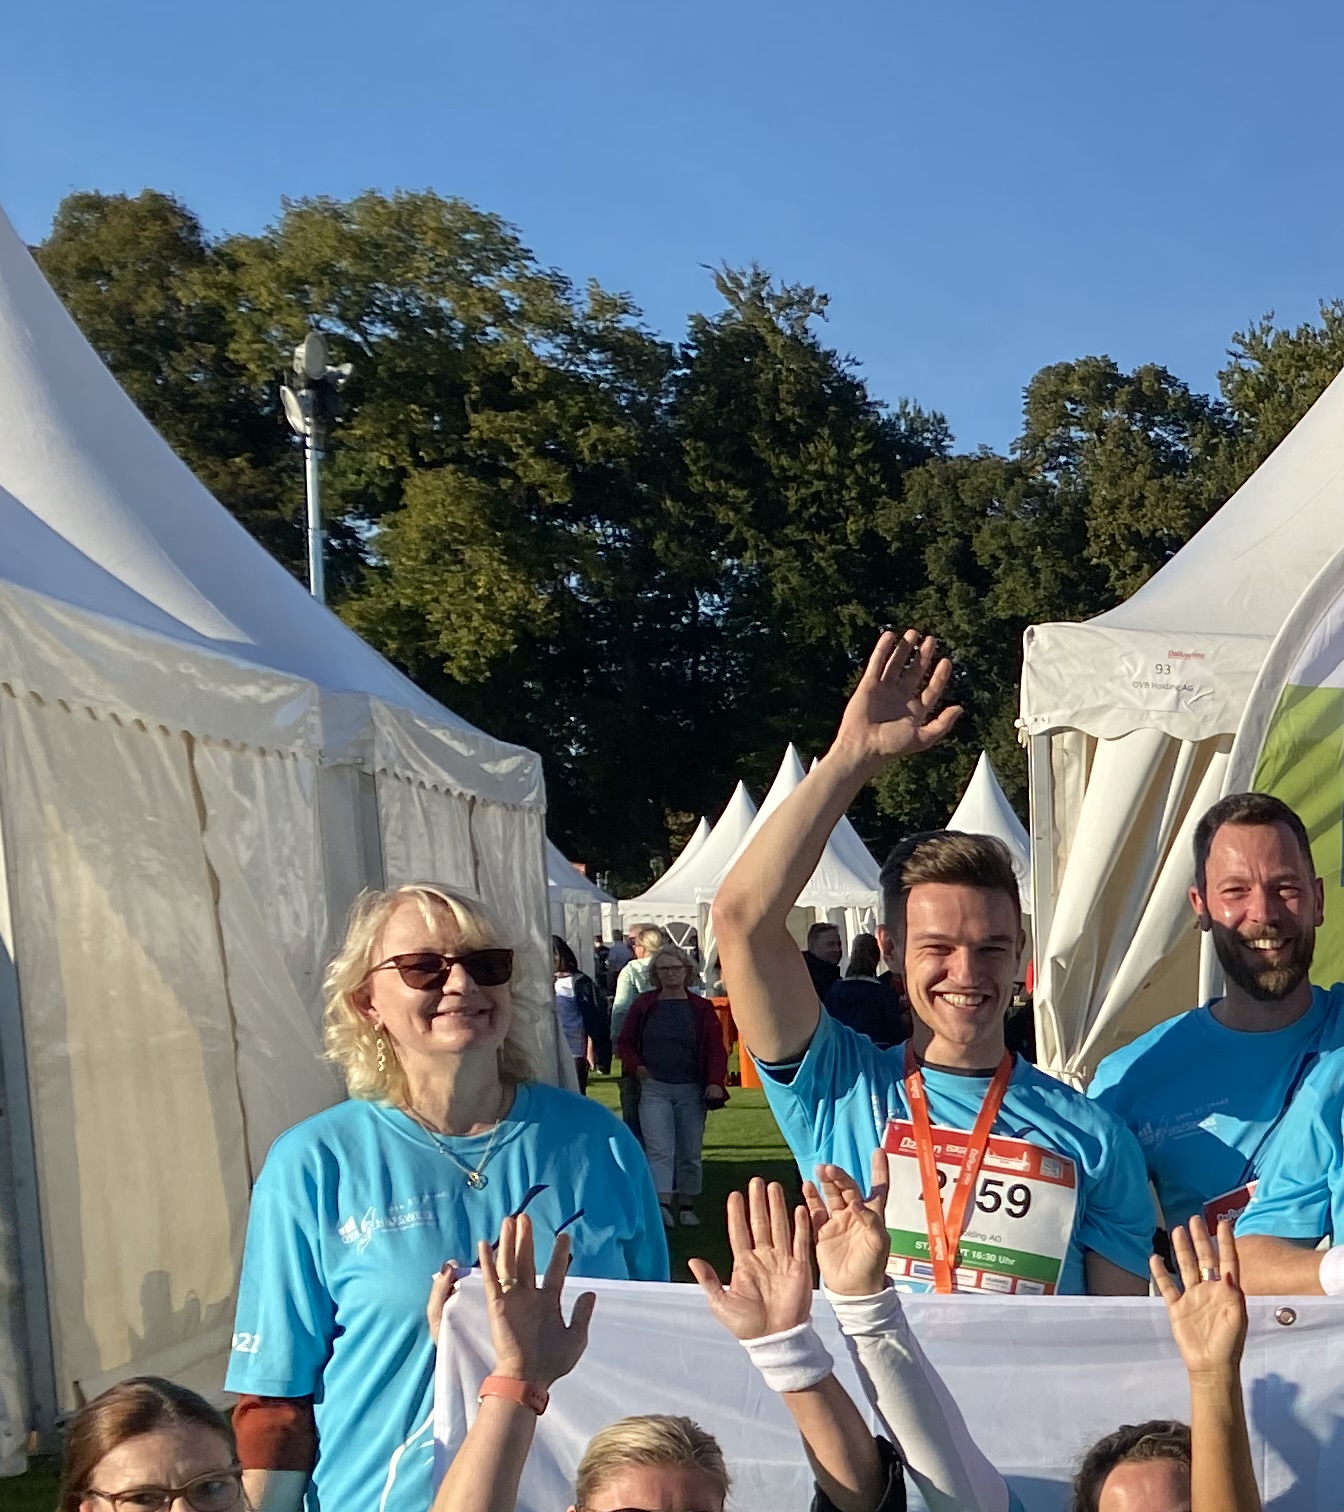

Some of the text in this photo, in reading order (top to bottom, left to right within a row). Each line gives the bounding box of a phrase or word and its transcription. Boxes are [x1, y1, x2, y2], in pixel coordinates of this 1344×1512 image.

[1155, 663, 1171, 675] 93
[1132, 681, 1150, 689] OVB
[919, 1168, 1032, 1219] 59
[963, 1230, 987, 1241] olding
[998, 1254, 1016, 1266] Uhr
